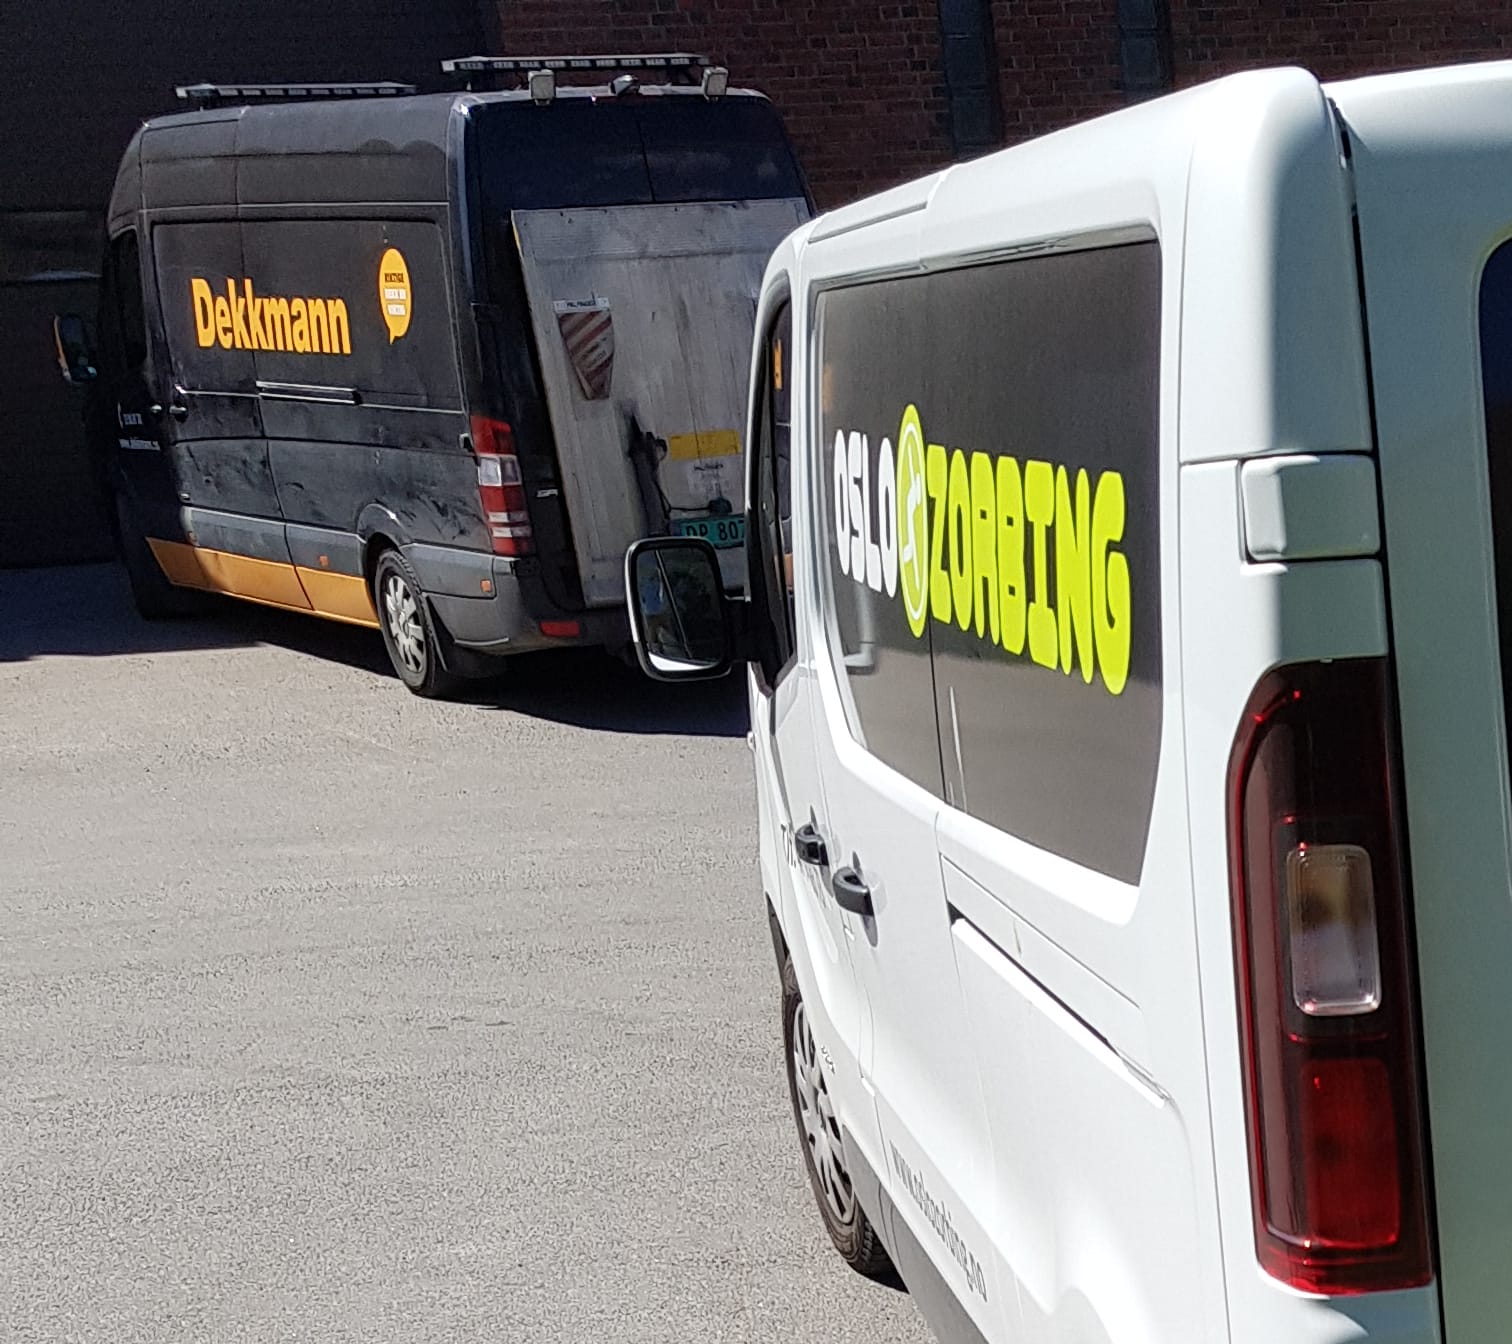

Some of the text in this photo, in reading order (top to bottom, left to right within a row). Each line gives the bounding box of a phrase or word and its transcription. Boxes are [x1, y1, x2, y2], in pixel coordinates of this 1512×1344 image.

[191, 278, 352, 354] Dekkmann
[834, 429, 1131, 695] OSLO ZORBING
